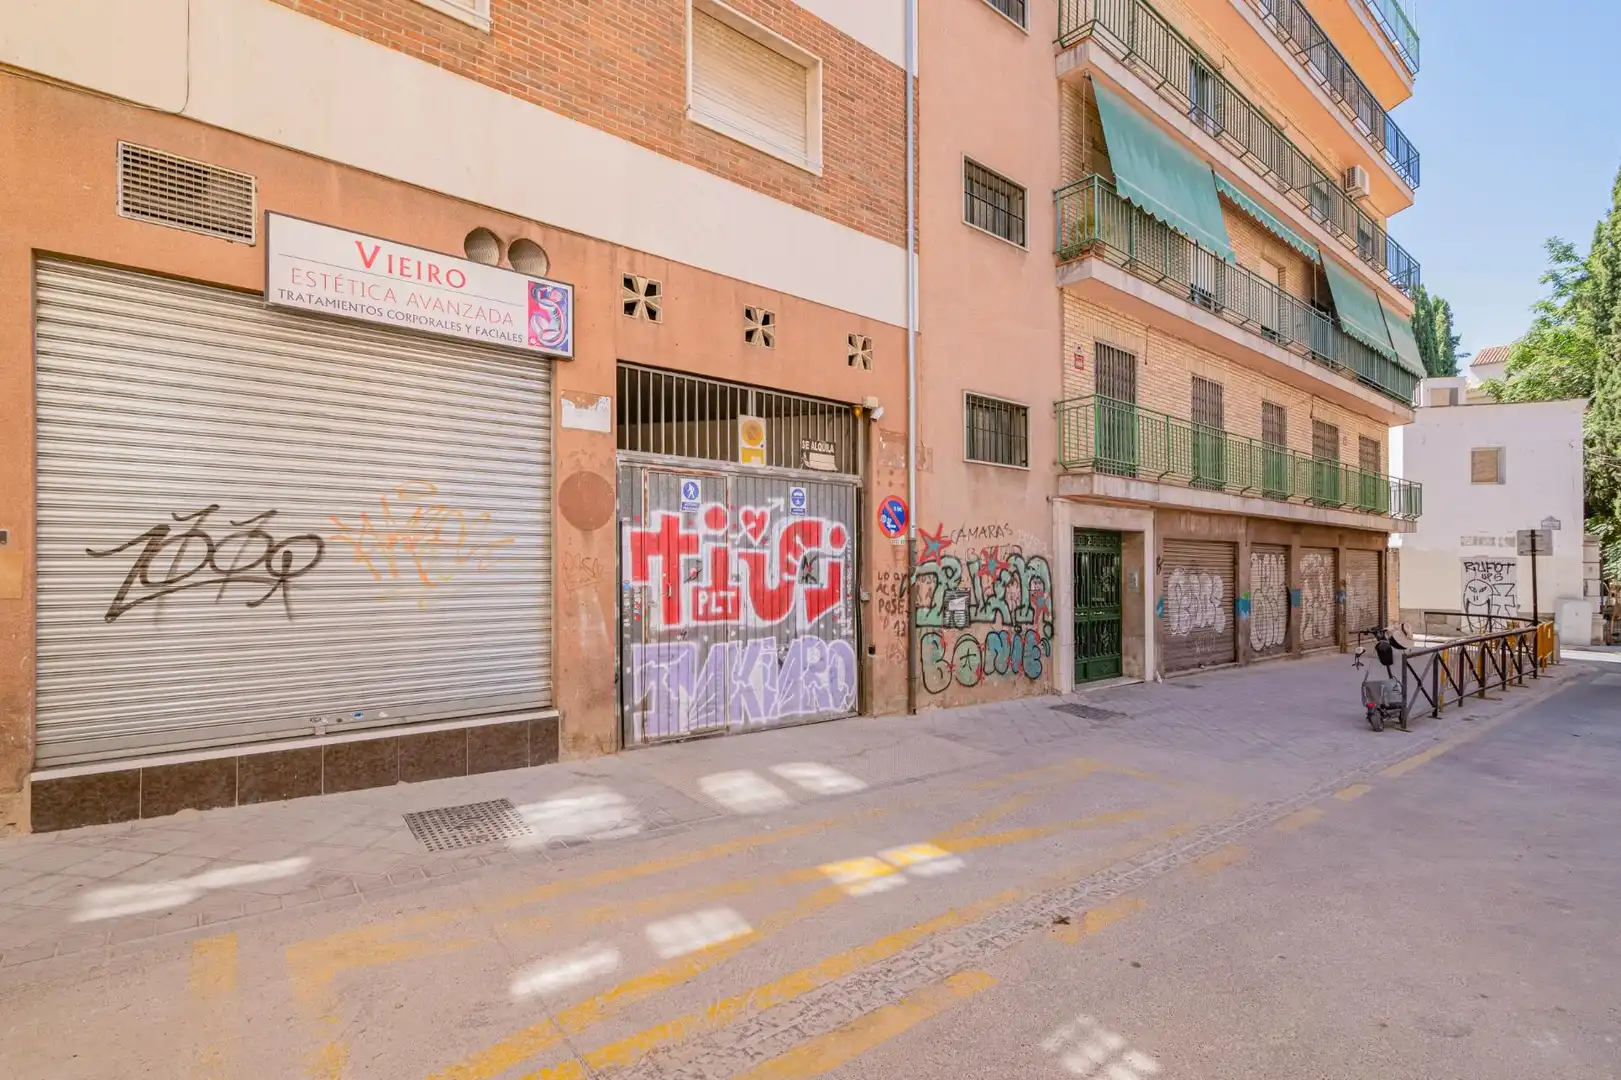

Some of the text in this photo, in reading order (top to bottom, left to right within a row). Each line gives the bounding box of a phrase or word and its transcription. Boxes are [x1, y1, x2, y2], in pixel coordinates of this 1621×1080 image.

[355, 240, 466, 289] VIEIRO
[278, 288, 523, 343] TRATAMIENTOS CORPORALES Y FACIALES
[291, 267, 514, 327] ESTÉTICA AVANZADA
[802, 439, 835, 453] SE ALQUILA
